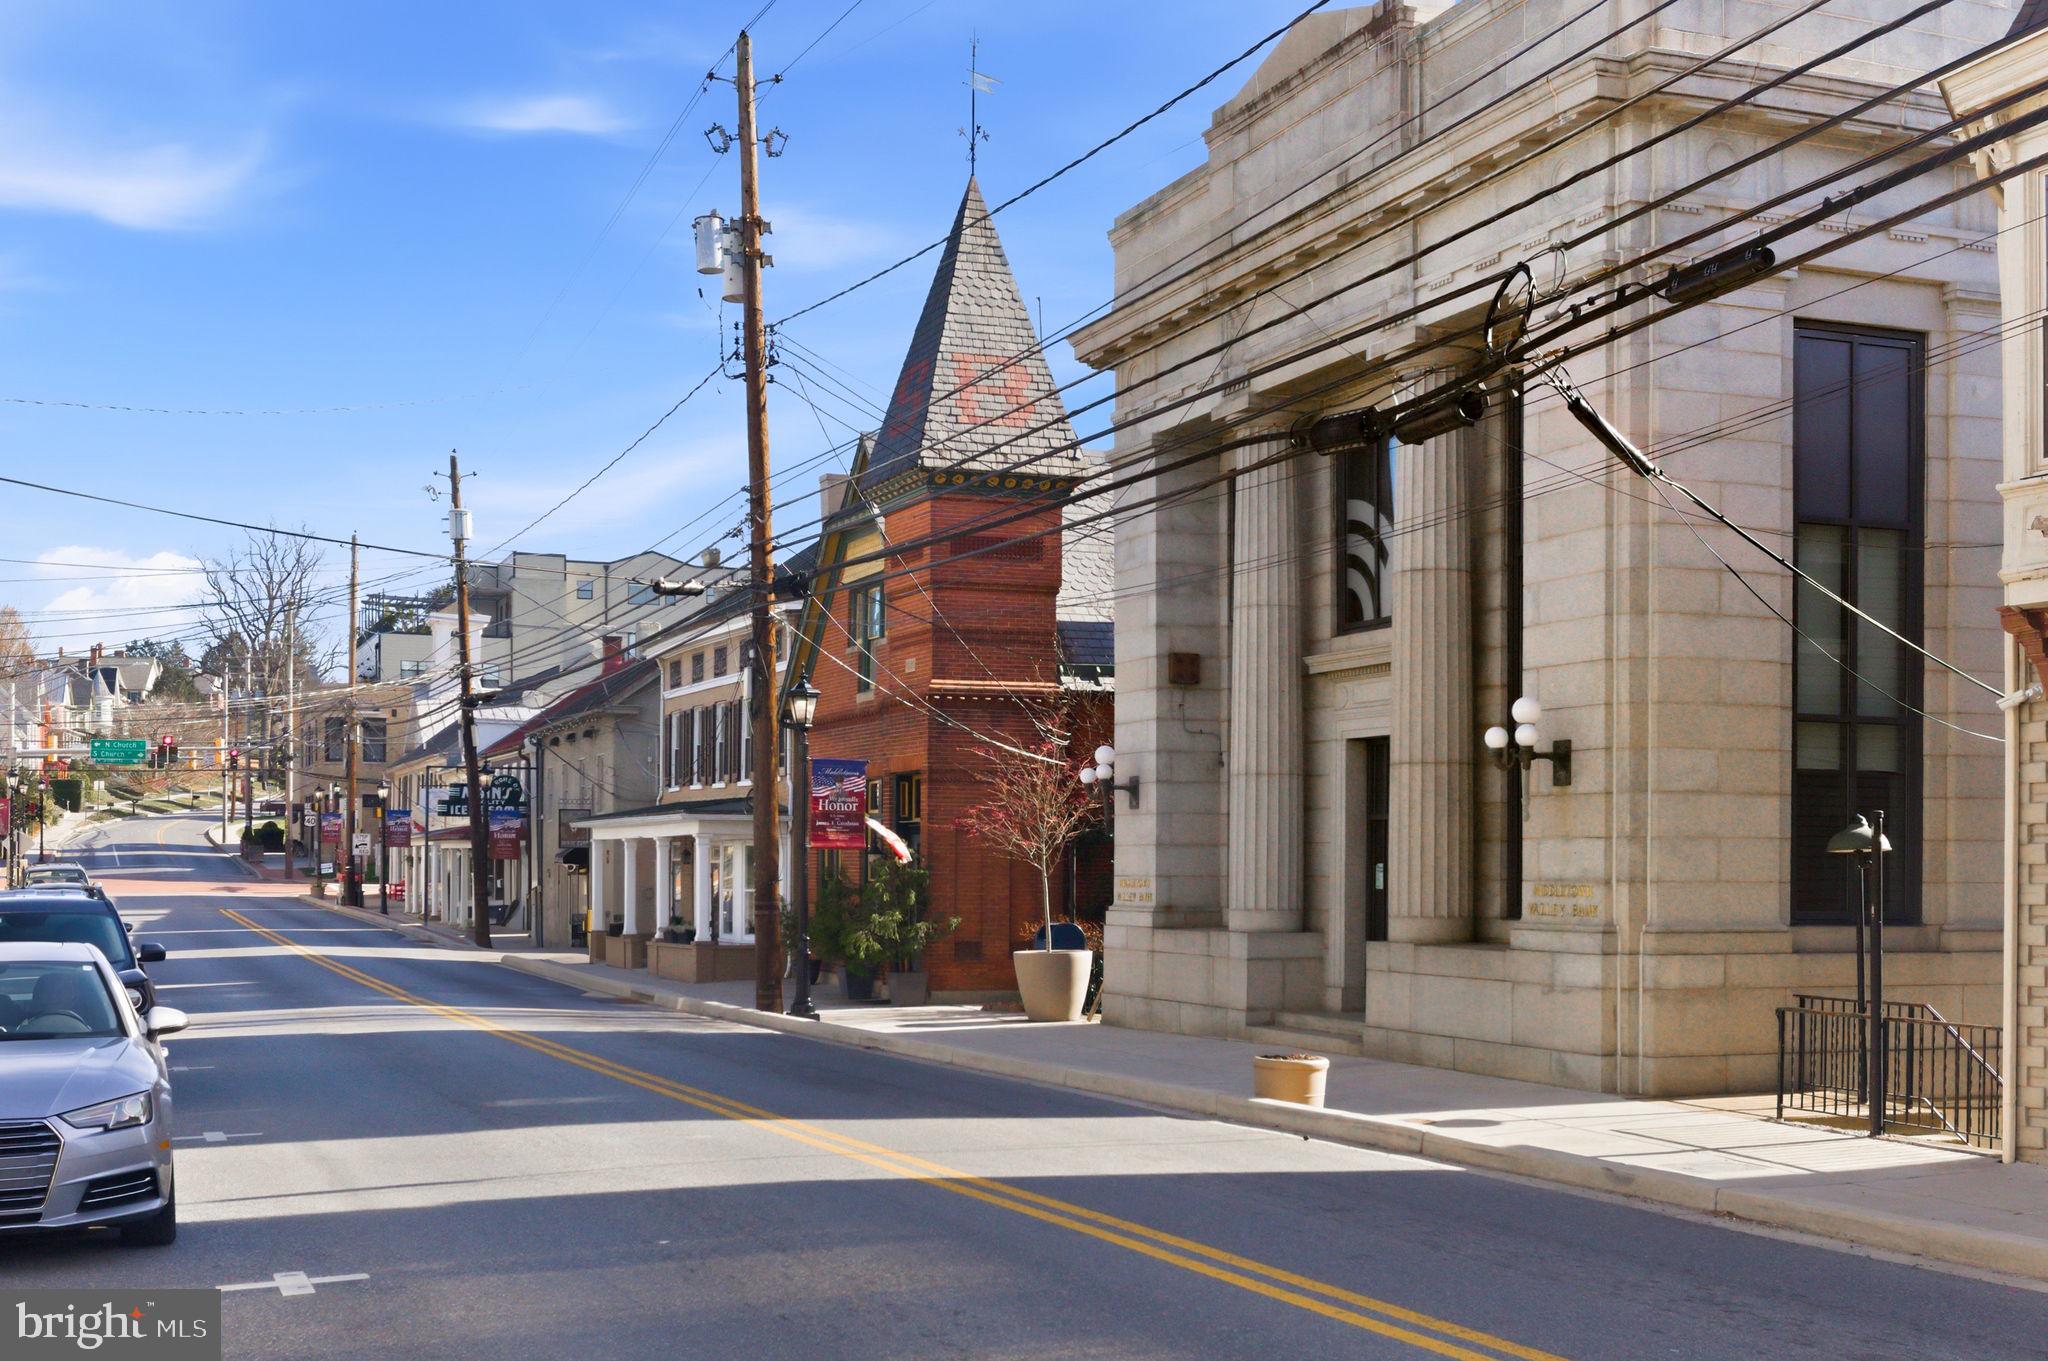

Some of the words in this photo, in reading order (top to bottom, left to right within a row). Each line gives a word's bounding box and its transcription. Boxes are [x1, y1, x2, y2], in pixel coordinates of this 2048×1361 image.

[450, 805, 468, 815] ICE
[818, 799, 859, 812] Honor
[306, 817, 316, 825] 40
[1528, 903, 1566, 917] VALLEY
[1572, 903, 1599, 917] BANK
